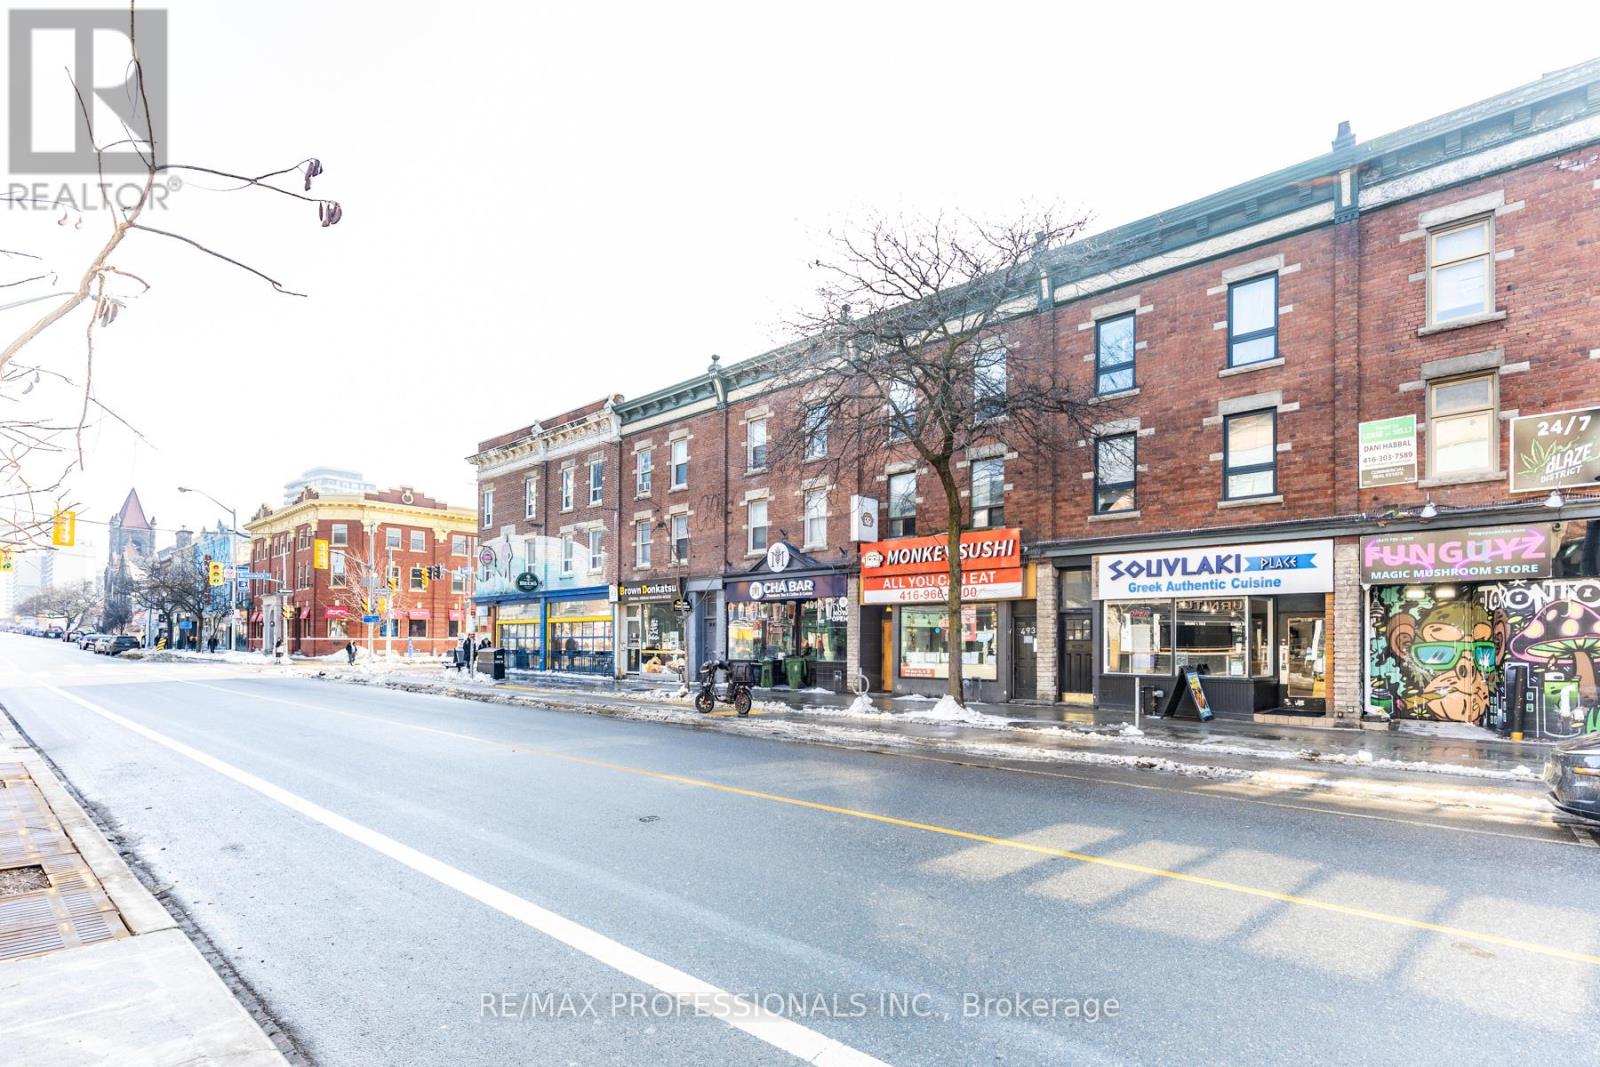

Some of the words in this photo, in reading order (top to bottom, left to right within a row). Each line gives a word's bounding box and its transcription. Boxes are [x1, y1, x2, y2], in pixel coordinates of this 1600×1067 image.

[1537, 415, 1592, 437] 24/7
[1363, 443, 1381, 453] DANI
[1382, 439, 1412, 449] HABBAL
[1362, 451, 1413, 464] 416-303-7589
[959, 538, 1014, 561] SUSHI
[1108, 554, 1242, 581] SOUVLAKI
[1260, 556, 1297, 570] PLACE
[1370, 570, 1411, 580] MAGIC
[1413, 566, 1491, 578] MUSHROOM
[1494, 564, 1539, 575] STORE
[788, 580, 814, 592] BAR
[882, 577, 906, 589] ALL
[908, 574, 935, 588] YOU
[969, 570, 997, 584] EAT
[1128, 581, 1162, 593] Greek
[1166, 578, 1226, 592] Authentic
[1231, 576, 1281, 589] Cuisine
[619, 586, 641, 596] Brown
[642, 584, 677, 595] Donkatsu
[899, 587, 977, 601] 416-966-00
